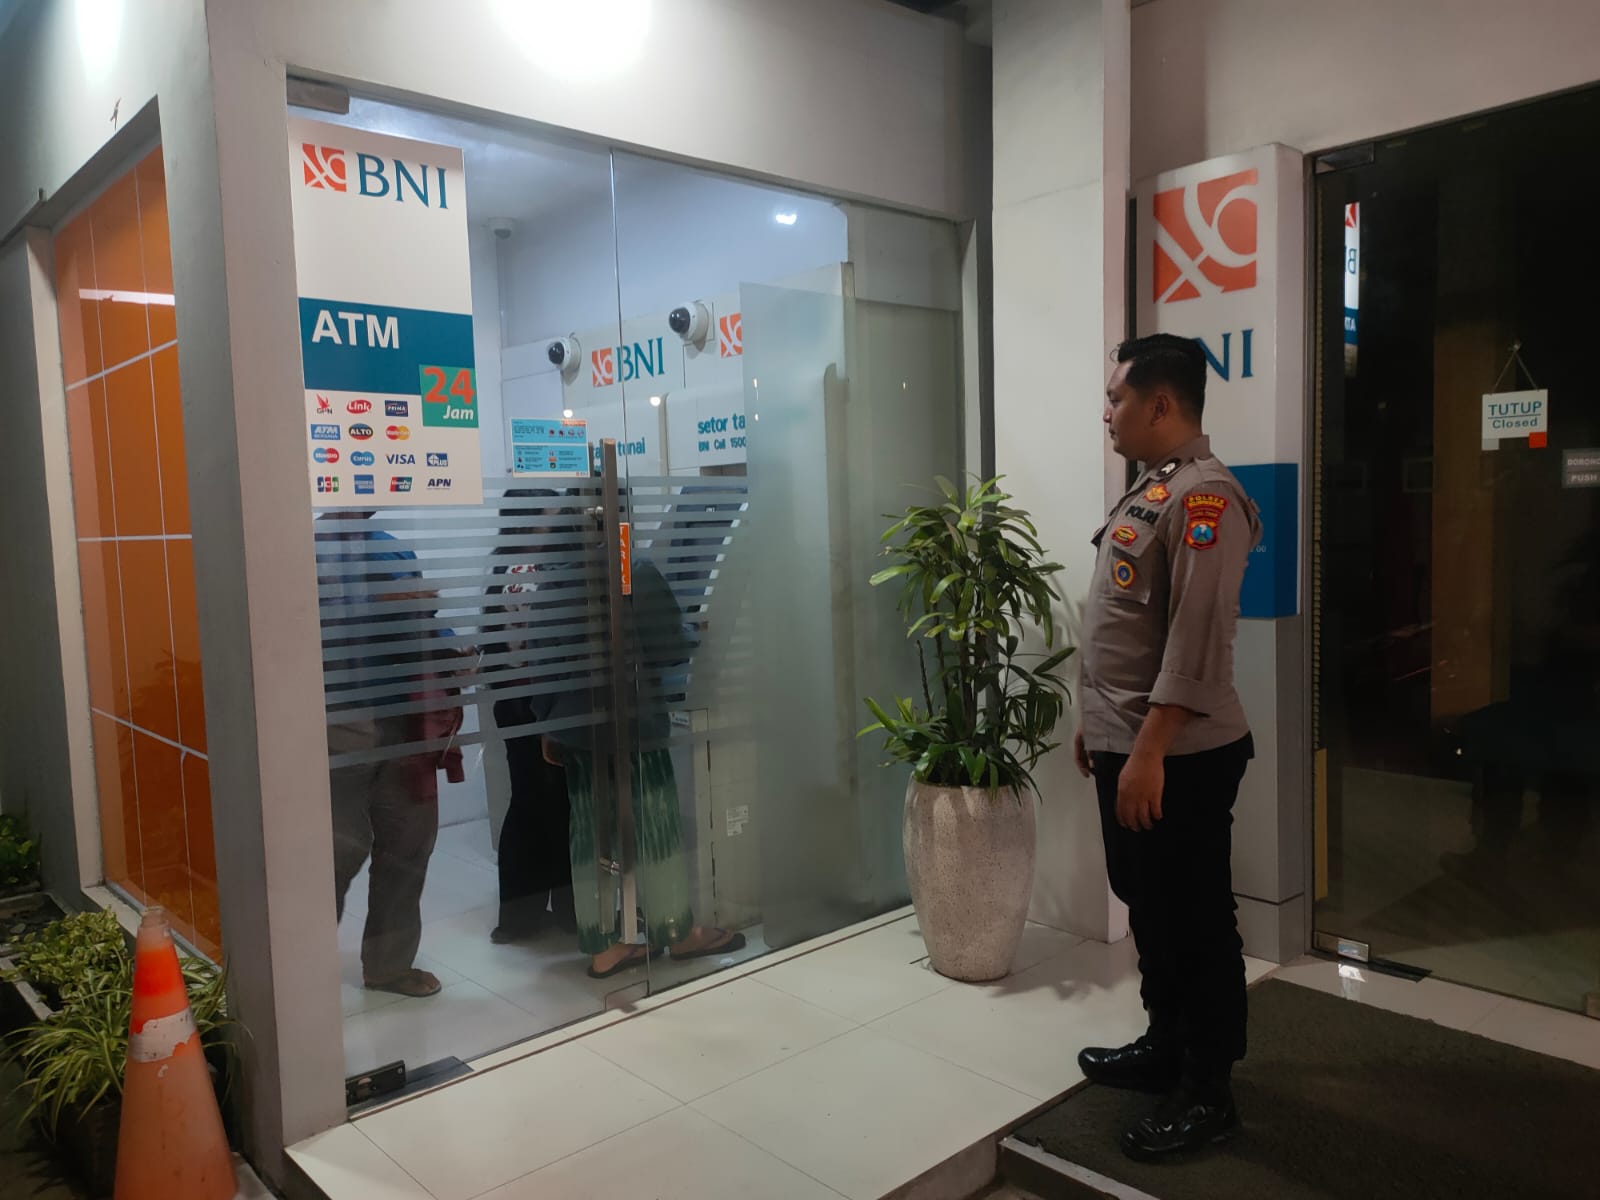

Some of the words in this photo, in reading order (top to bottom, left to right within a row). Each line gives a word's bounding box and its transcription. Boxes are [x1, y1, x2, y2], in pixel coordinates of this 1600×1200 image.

[356, 152, 448, 209] BNI
[312, 309, 400, 349] ATM
[616, 337, 664, 382] BNI
[1193, 329, 1254, 382] NI
[424, 366, 475, 404] 24
[443, 405, 474, 420] Jam
[1488, 401, 1542, 416] TUTUP
[314, 426, 338, 434] ATM
[697, 416, 728, 434] setor
[1492, 417, 1538, 429] Closed
[386, 454, 416, 464] VISA
[428, 479, 452, 488] APN
[1571, 474, 1598, 482] PUSH
[1125, 505, 1159, 524] POLRI
